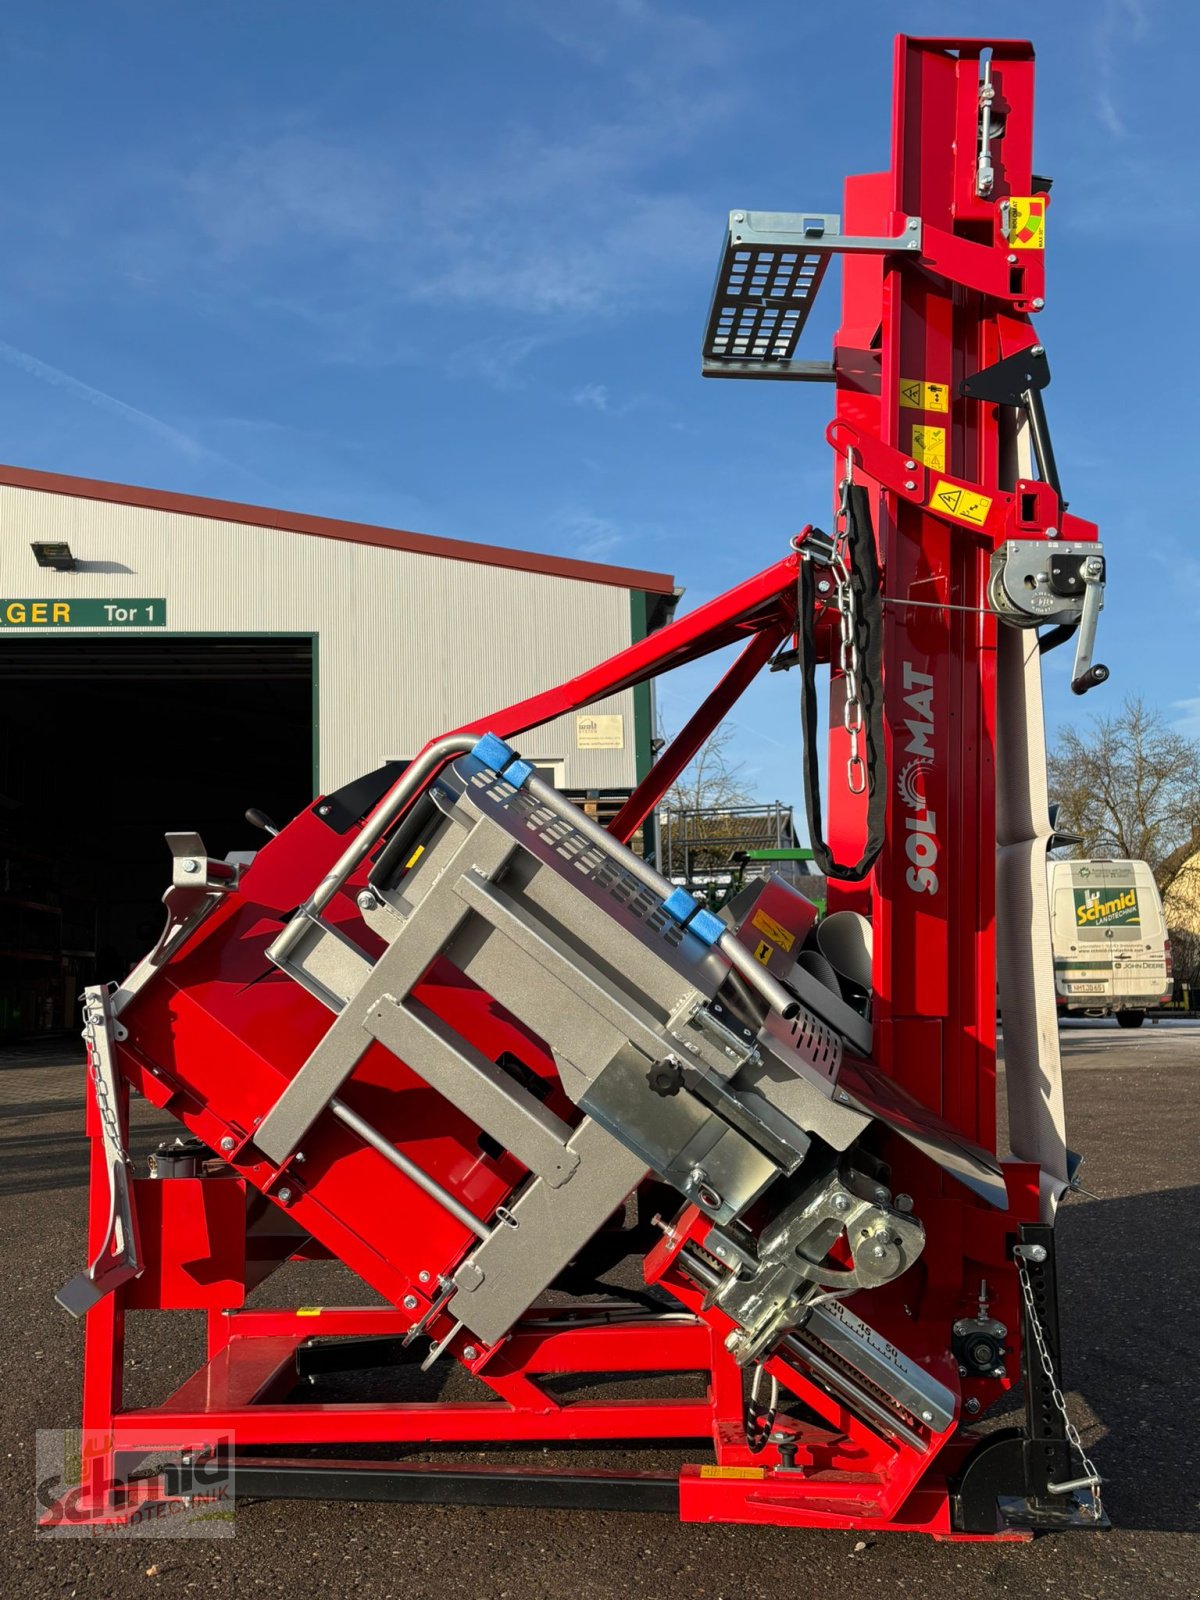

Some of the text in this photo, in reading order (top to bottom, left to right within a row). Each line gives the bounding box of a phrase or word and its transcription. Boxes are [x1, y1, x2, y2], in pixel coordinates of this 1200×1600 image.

[0, 602, 154, 623] GER Tor 1
[897, 660, 940, 896] SOLOMAT
[1077, 888, 1136, 926] Schmid
[831, 1302, 844, 1315] 40
[857, 1323, 871, 1336] 45
[885, 1343, 898, 1358] 50
